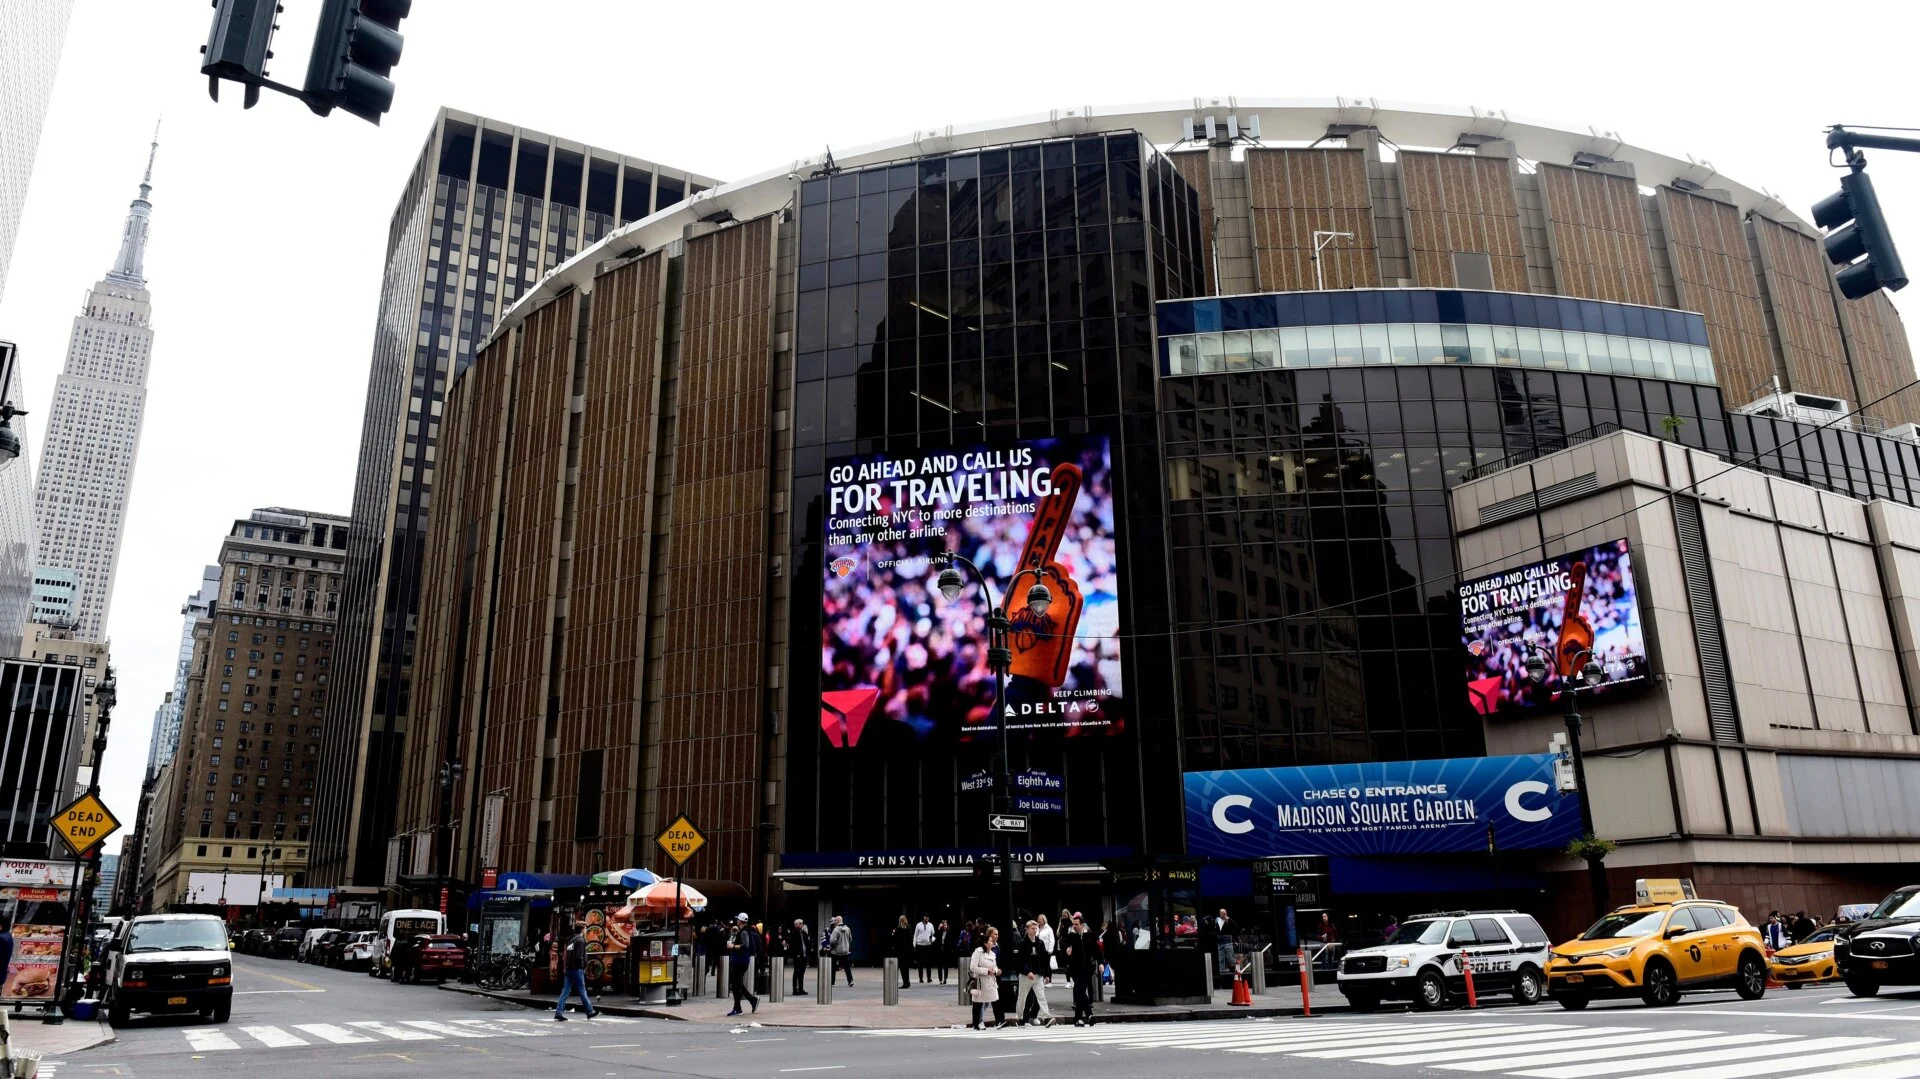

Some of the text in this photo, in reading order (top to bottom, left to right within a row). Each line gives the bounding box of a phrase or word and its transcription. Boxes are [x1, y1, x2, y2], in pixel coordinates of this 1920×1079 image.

[830, 448, 1032, 484] GO AHEAD AND CALL US
[830, 483, 883, 515] FOR
[890, 467, 1060, 509] TRAVELING.
[829, 502, 1036, 530] Connecting NYC to more destinations
[829, 525, 948, 546] than any other airline.
[877, 560, 913, 568] OFFICIAL
[1460, 561, 1559, 597] GO AHEAD AND CALL US
[1461, 572, 1576, 615] FOR TRAVELING.
[1463, 612, 1494, 625] Connecting
[1494, 607, 1506, 617] NYC
[1514, 603, 1528, 612] more
[1529, 595, 1565, 609] destinations
[1464, 626, 1477, 634] than
[1487, 619, 1503, 629] other
[1054, 689, 1112, 698] KEEP CLIMBING
[1021, 701, 1081, 715] DELTA
[961, 777, 993, 791] West 33rd St
[1017, 775, 1060, 788] Eighth Ave
[1303, 783, 1447, 800] CHASE ENTRANCE
[1018, 799, 1030, 809] Joe
[1031, 800, 1049, 810] Louis
[1504, 780, 1553, 822] C
[68, 811, 104, 823] DEAD
[1211, 794, 1255, 834] C
[1277, 798, 1476, 827] MADISON SQUARE GARDEN
[70, 826, 96, 837] END
[668, 830, 695, 839] DEAD
[671, 843, 690, 852] END
[5, 860, 46, 870] YOUR AD
[858, 852, 1045, 866] PENNSYLVANIA STION
[1272, 859, 1309, 872] STATION
[1176, 871, 1191, 879] TAXI
[506, 878, 518, 892] D
[396, 920, 412, 929] ONE
[1469, 960, 1512, 973] POLICE
